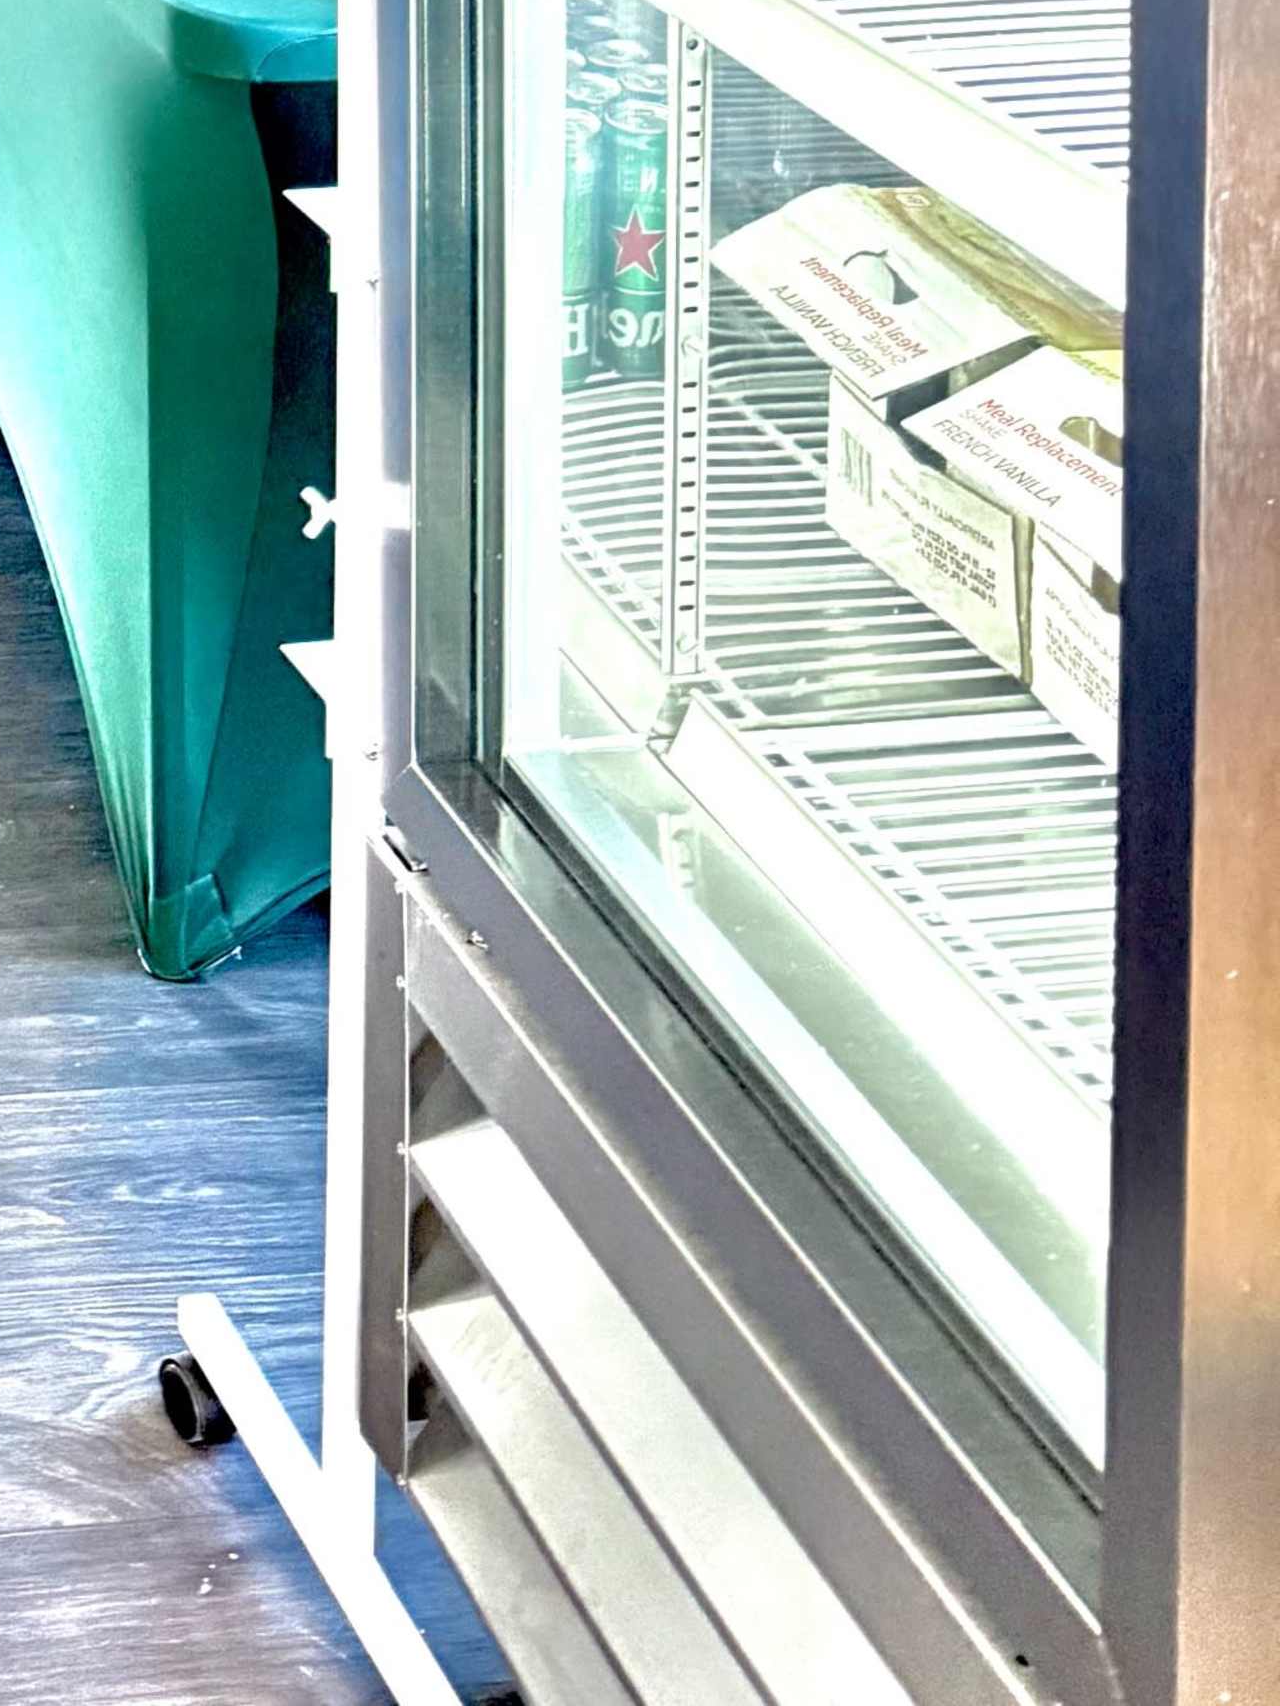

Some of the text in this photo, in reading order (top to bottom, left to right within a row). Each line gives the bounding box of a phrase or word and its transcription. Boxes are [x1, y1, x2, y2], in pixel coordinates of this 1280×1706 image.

[977, 398, 1025, 428] Meal
[932, 418, 1062, 509] FRENCH VANILLA
